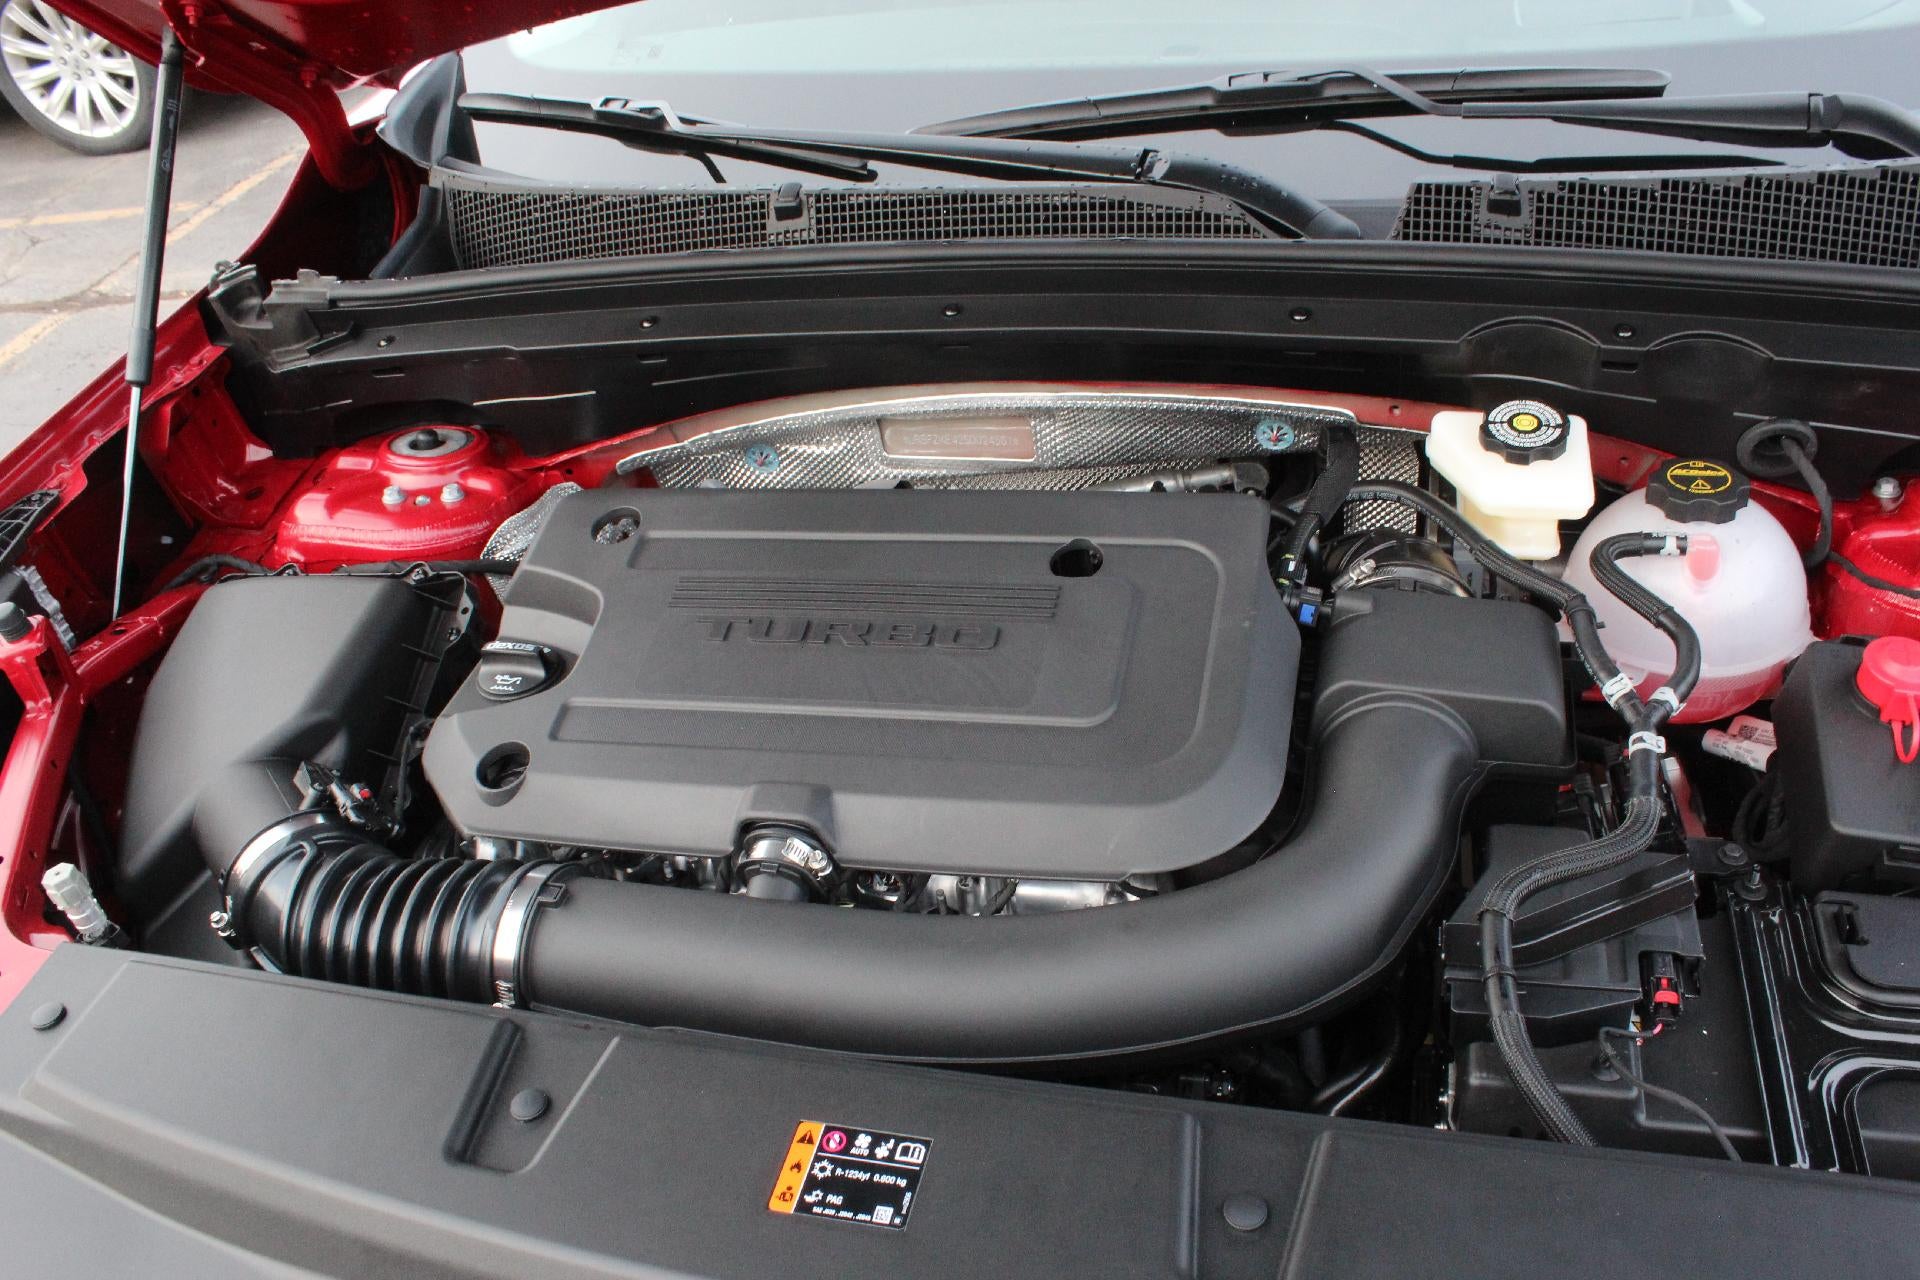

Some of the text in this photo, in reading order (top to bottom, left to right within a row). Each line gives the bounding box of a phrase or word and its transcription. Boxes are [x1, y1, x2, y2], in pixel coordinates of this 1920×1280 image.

[696, 616, 1001, 651] TURBO
[486, 641, 536, 651] dexos
[850, 1147, 870, 1156] AUTO
[834, 1169, 871, 1182] R-1234yf
[896, 1175, 907, 1187] kg
[825, 1194, 844, 1205] PAG
